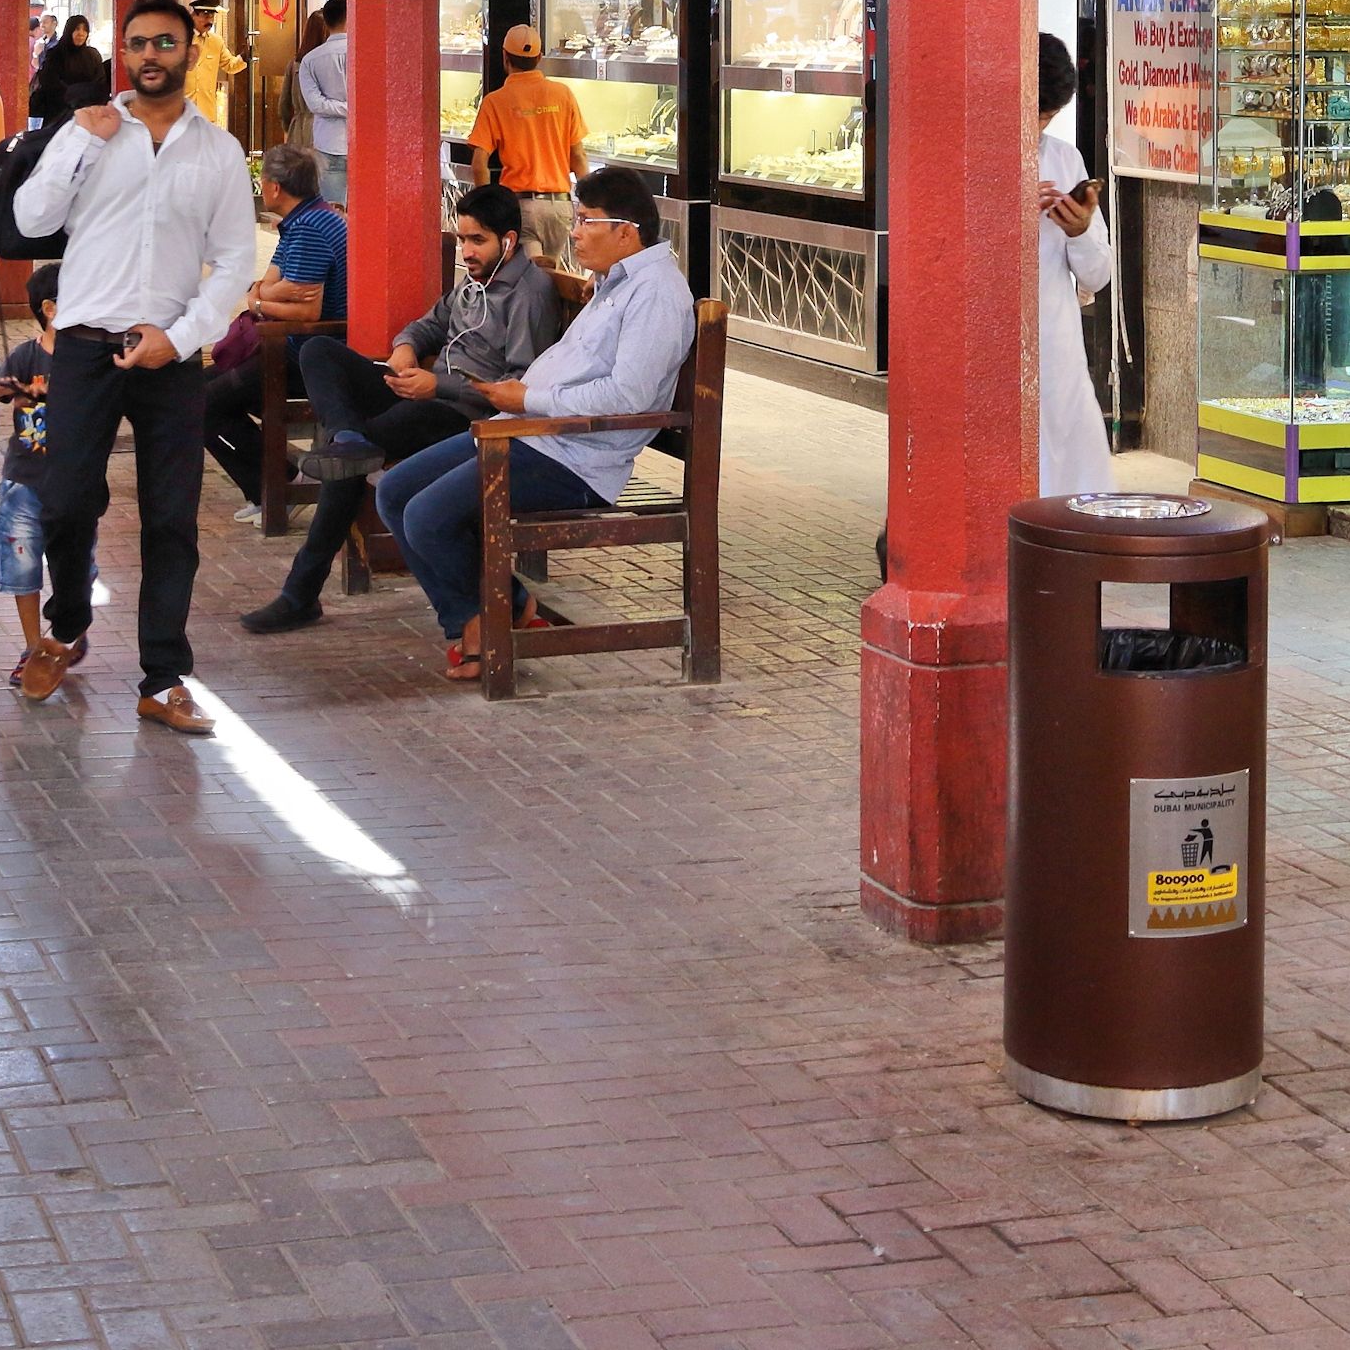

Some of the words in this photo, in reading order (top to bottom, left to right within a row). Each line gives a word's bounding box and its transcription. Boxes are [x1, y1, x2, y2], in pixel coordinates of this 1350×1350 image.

[1134, 20, 1148, 47] We
[1150, 21, 1166, 54] Buy
[1169, 21, 1176, 49] &
[1118, 59, 1142, 91] Gold,
[1143, 60, 1181, 89] Diamond
[1182, 62, 1189, 90] &
[1124, 99, 1138, 125] We
[1140, 101, 1151, 126] do
[1152, 102, 1181, 130] Arabic
[1182, 103, 1190, 131] &
[1148, 141, 1172, 168] Name
[1173, 143, 1199, 173] Chain
[1153, 804, 1182, 814] DUBAI
[1184, 798, 1236, 812] MUNICIPALITY
[1155, 873, 1205, 887] 800900
